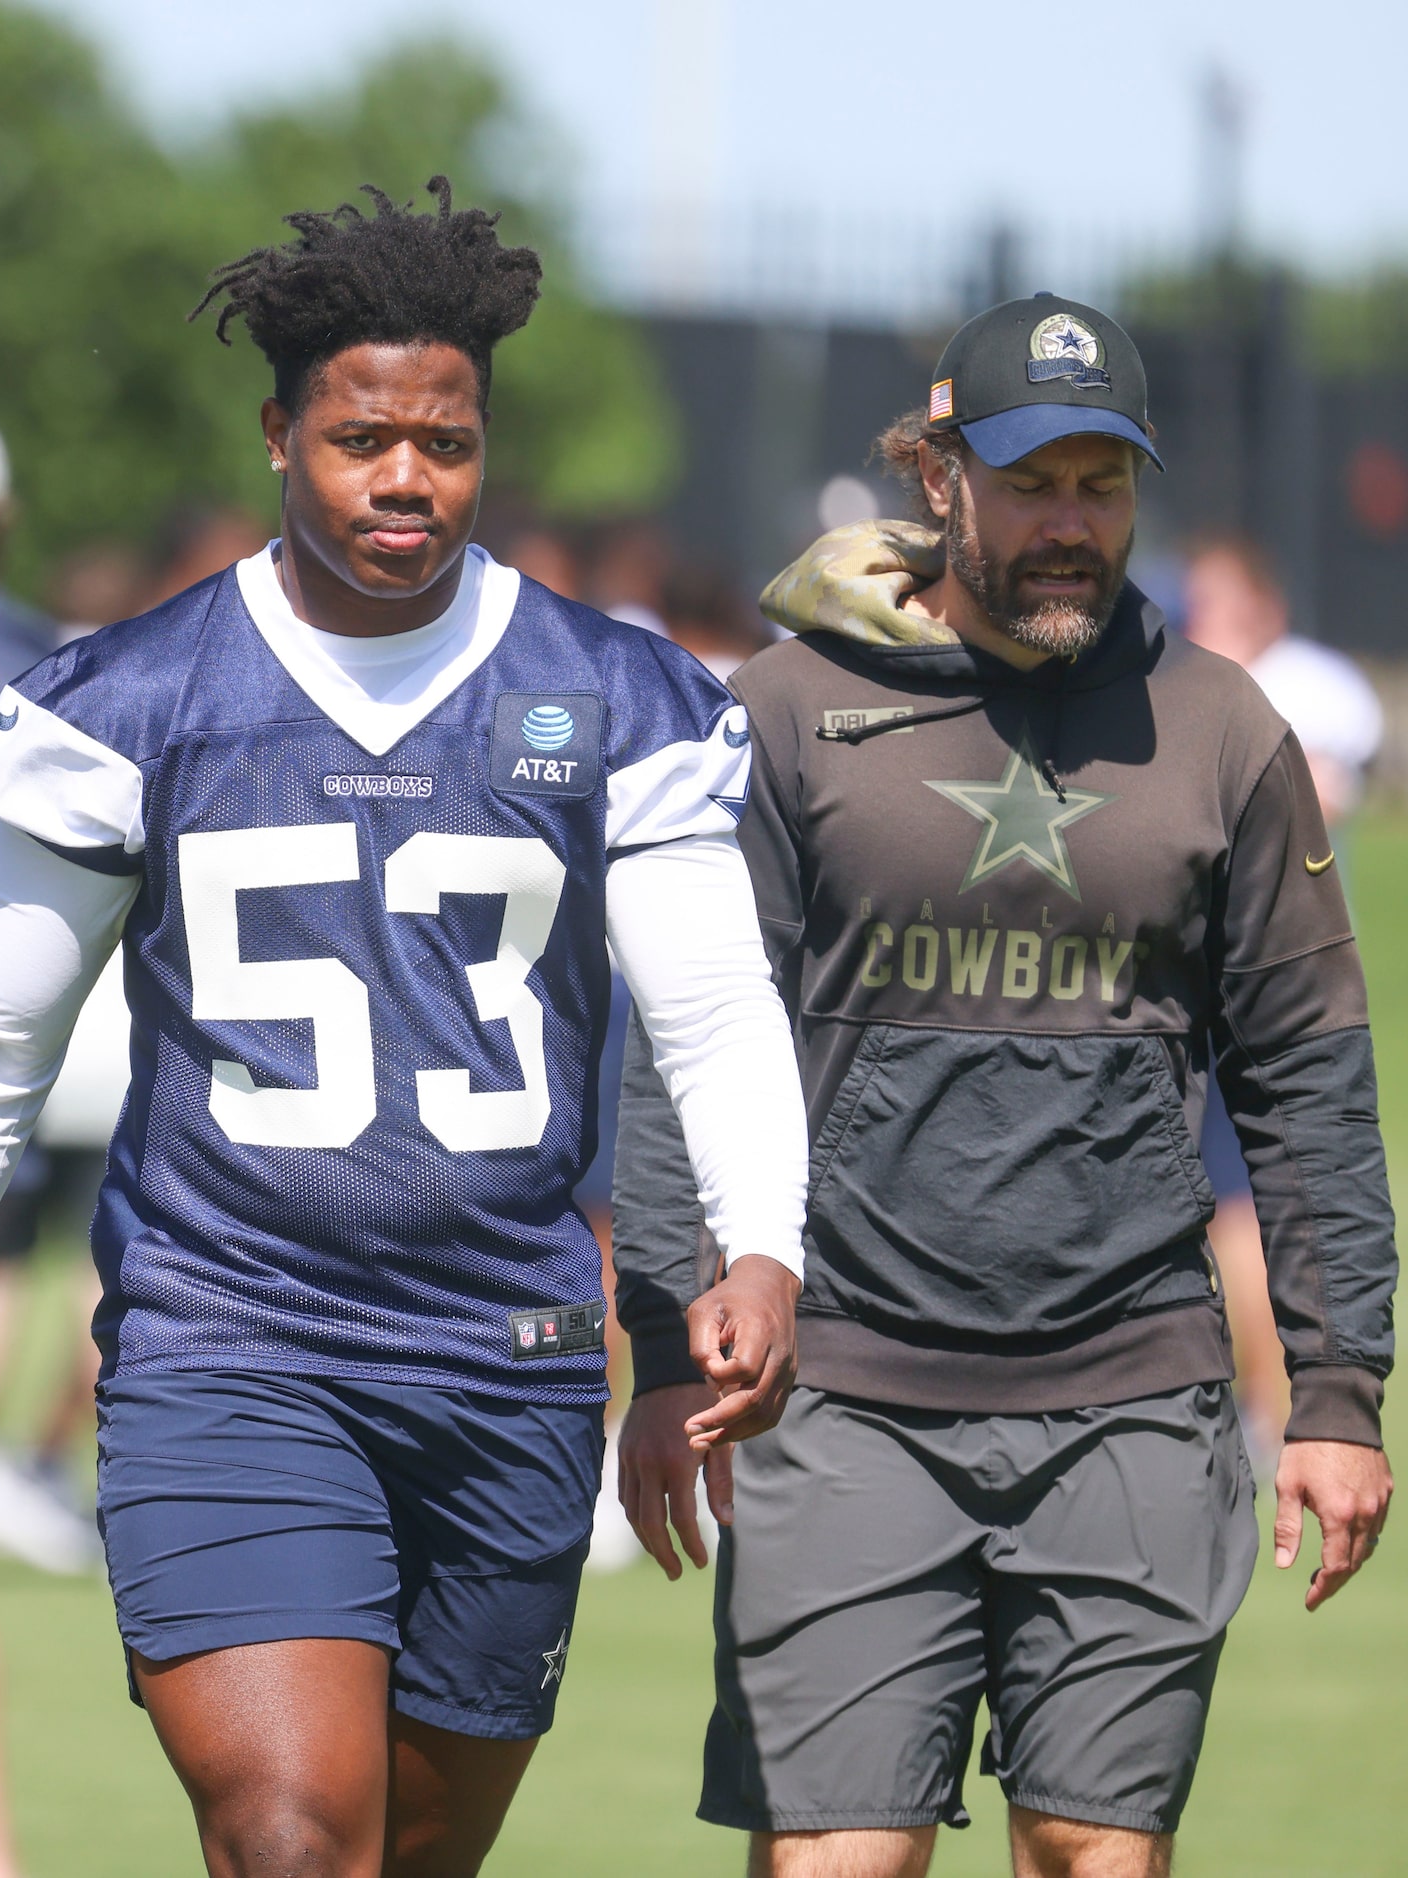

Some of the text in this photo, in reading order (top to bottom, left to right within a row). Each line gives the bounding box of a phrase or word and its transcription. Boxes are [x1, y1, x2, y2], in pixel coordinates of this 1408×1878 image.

[323, 775, 433, 797] COWBOYS
[512, 758, 577, 783] AT&T
[859, 896, 1115, 934] DALLA
[178, 822, 567, 1152] 53
